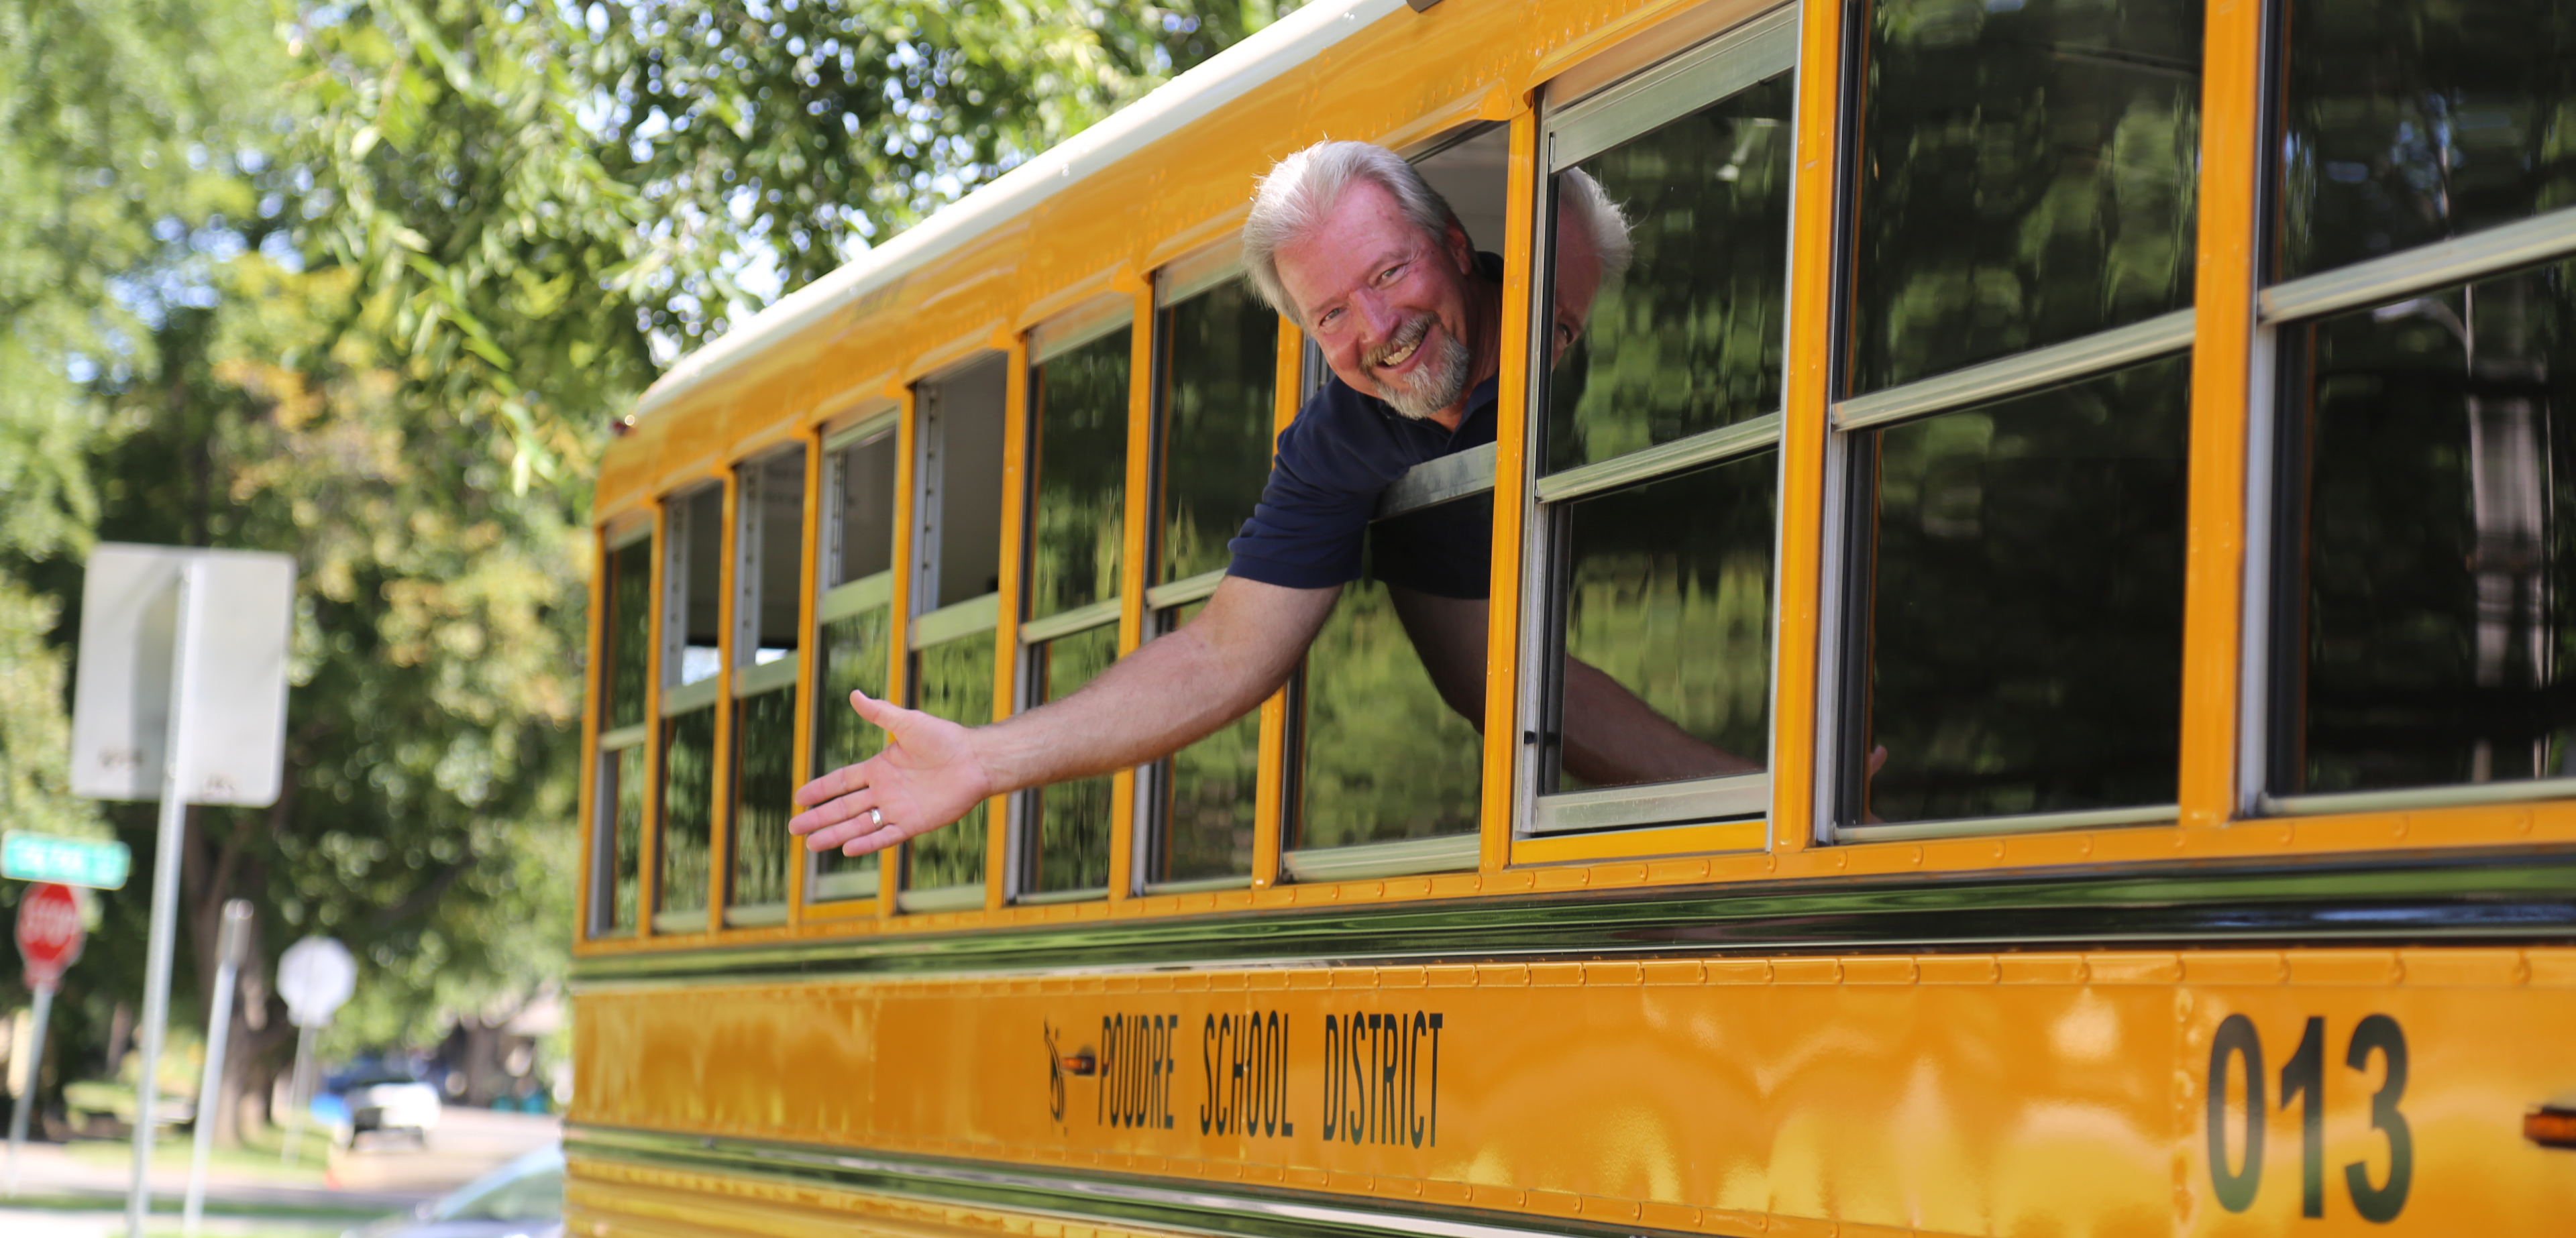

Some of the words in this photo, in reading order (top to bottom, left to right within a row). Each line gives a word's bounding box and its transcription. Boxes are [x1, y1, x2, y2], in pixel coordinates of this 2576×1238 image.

[19, 896, 76, 947] STOP
[1098, 1011, 1178, 1130] POUDRE
[1200, 1009, 1293, 1139] SCHOOL
[1323, 1009, 1444, 1149] DISTRICT
[2206, 1013, 2413, 1225] 013
